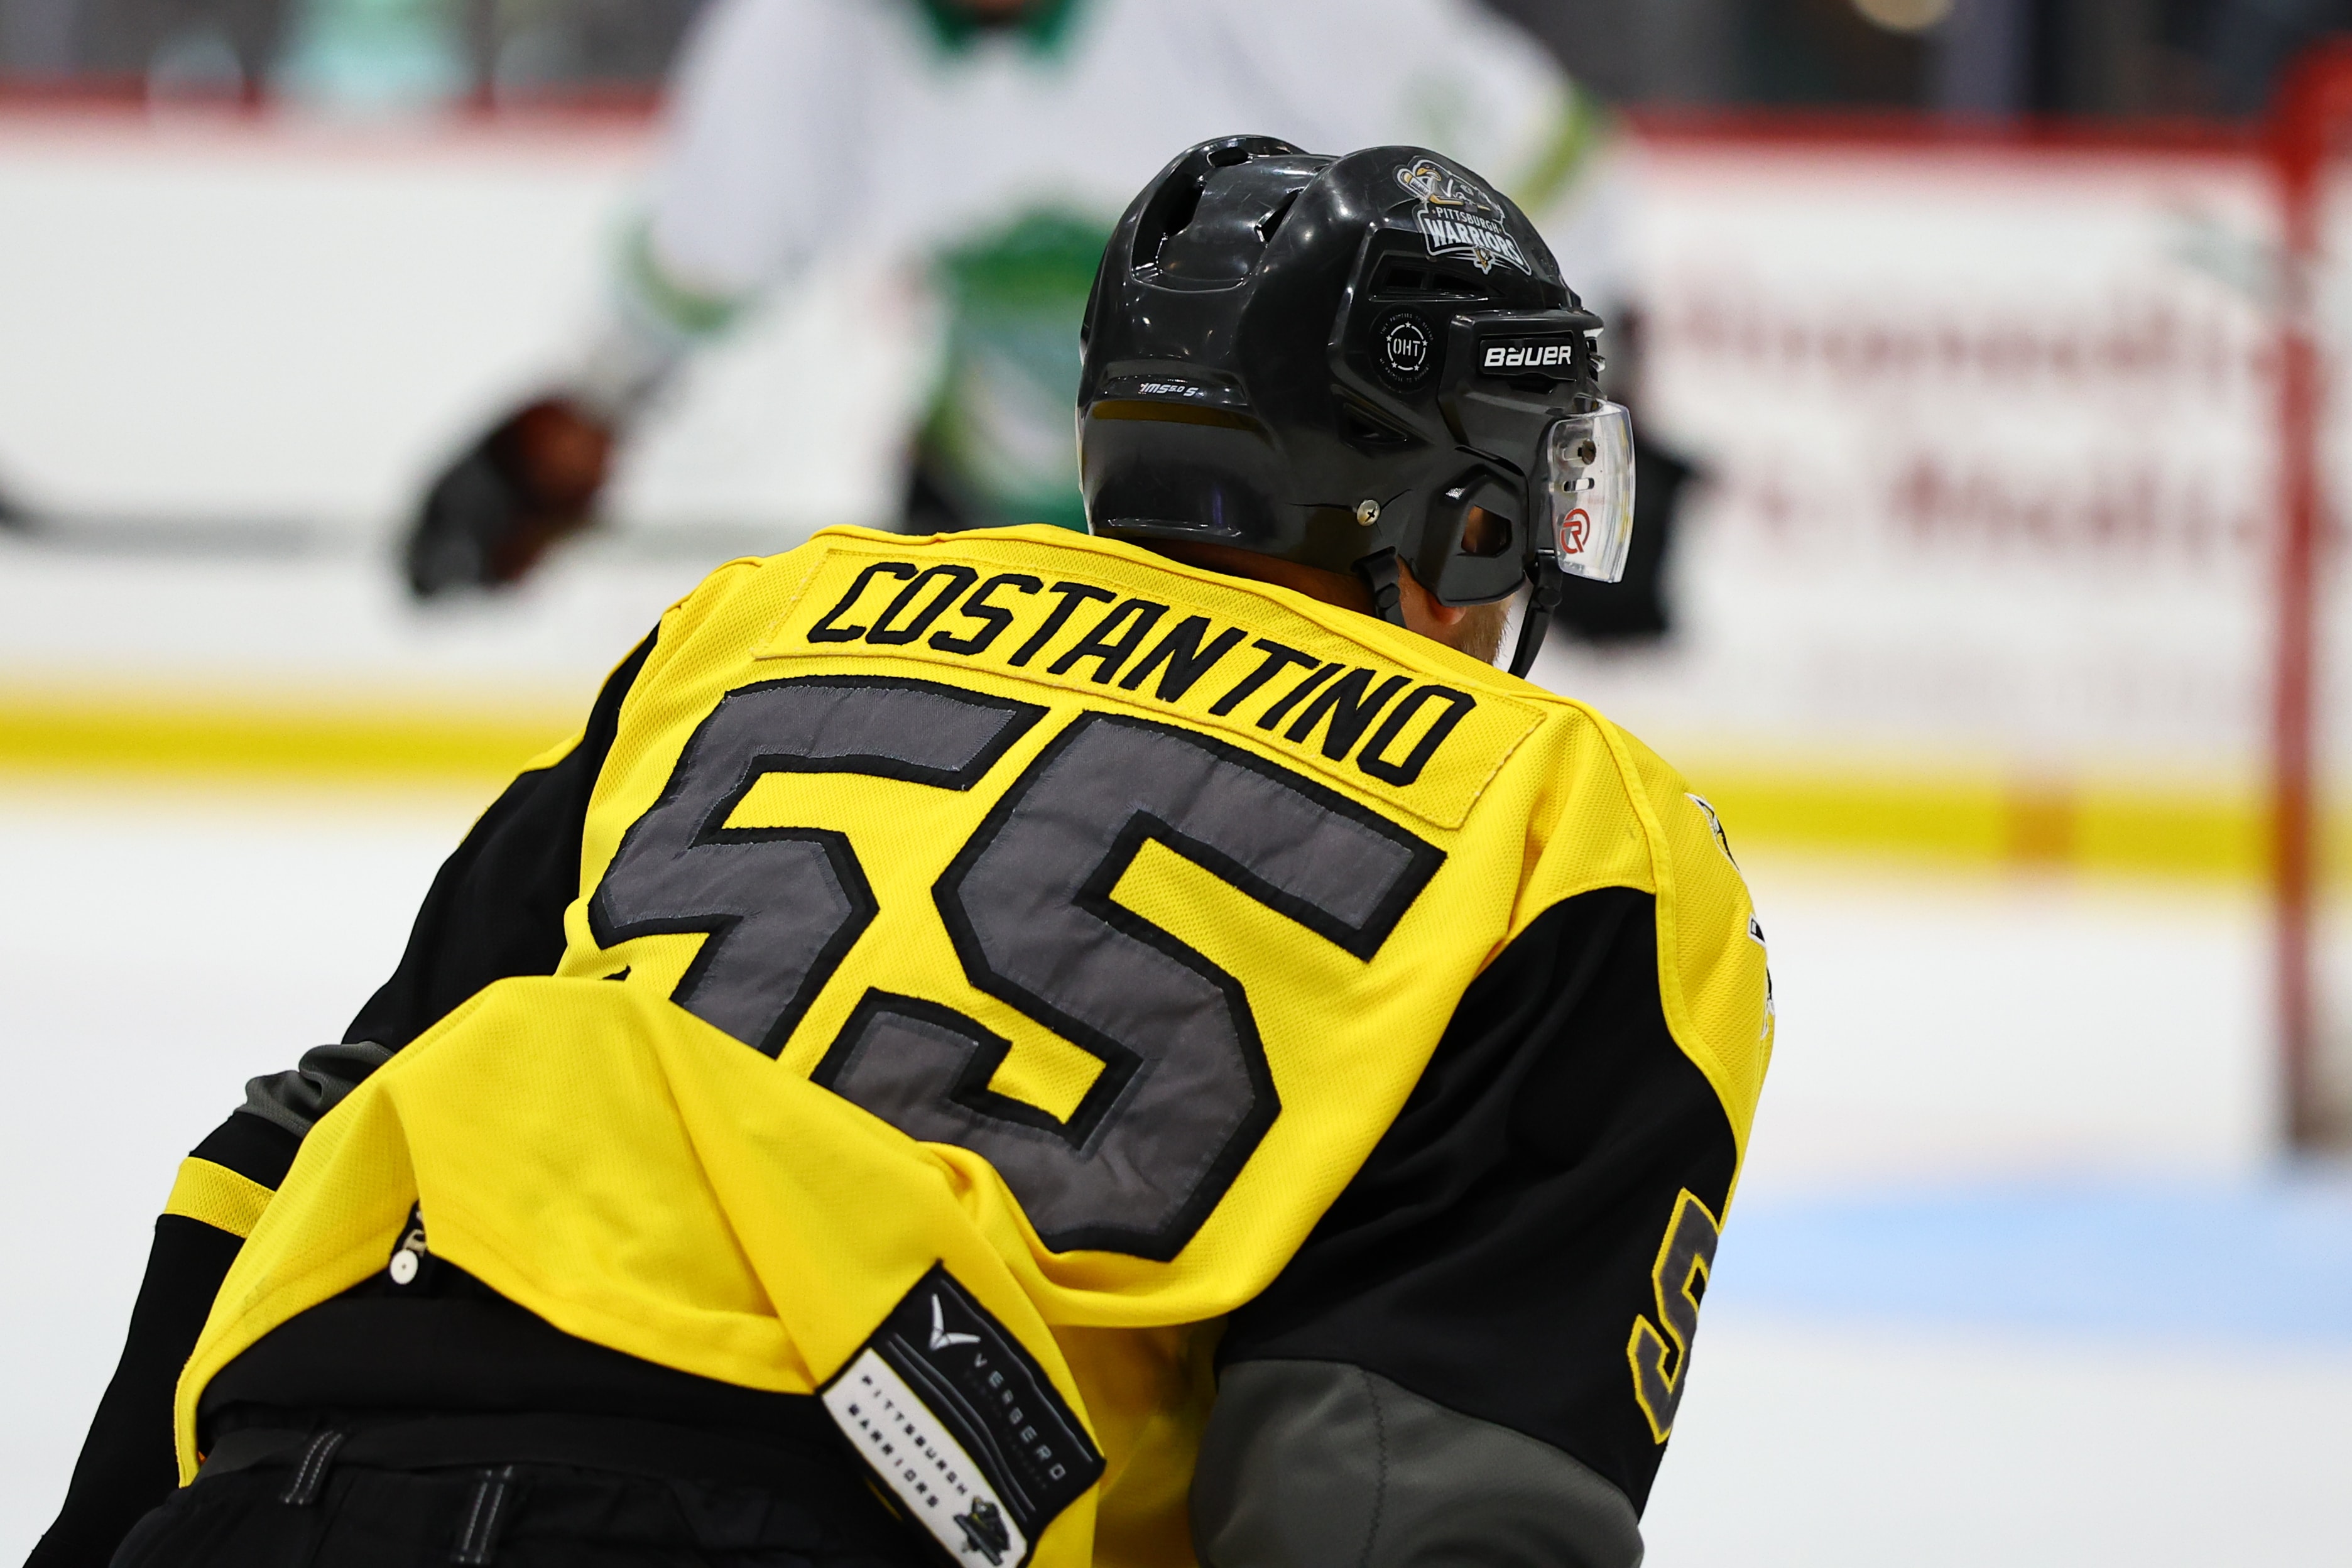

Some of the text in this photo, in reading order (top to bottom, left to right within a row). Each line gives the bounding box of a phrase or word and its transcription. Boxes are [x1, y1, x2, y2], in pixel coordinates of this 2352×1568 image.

[1424, 218, 1524, 266] WARRIORS
[1435, 206, 1500, 234] PITTSBURGH
[1392, 337, 1421, 357] OHT
[807, 560, 1476, 787] COSTANTINO
[587, 675, 1449, 1263] 55
[848, 1403, 939, 1508] WARRIORS
[861, 1375, 967, 1495] PITTSBURGH
